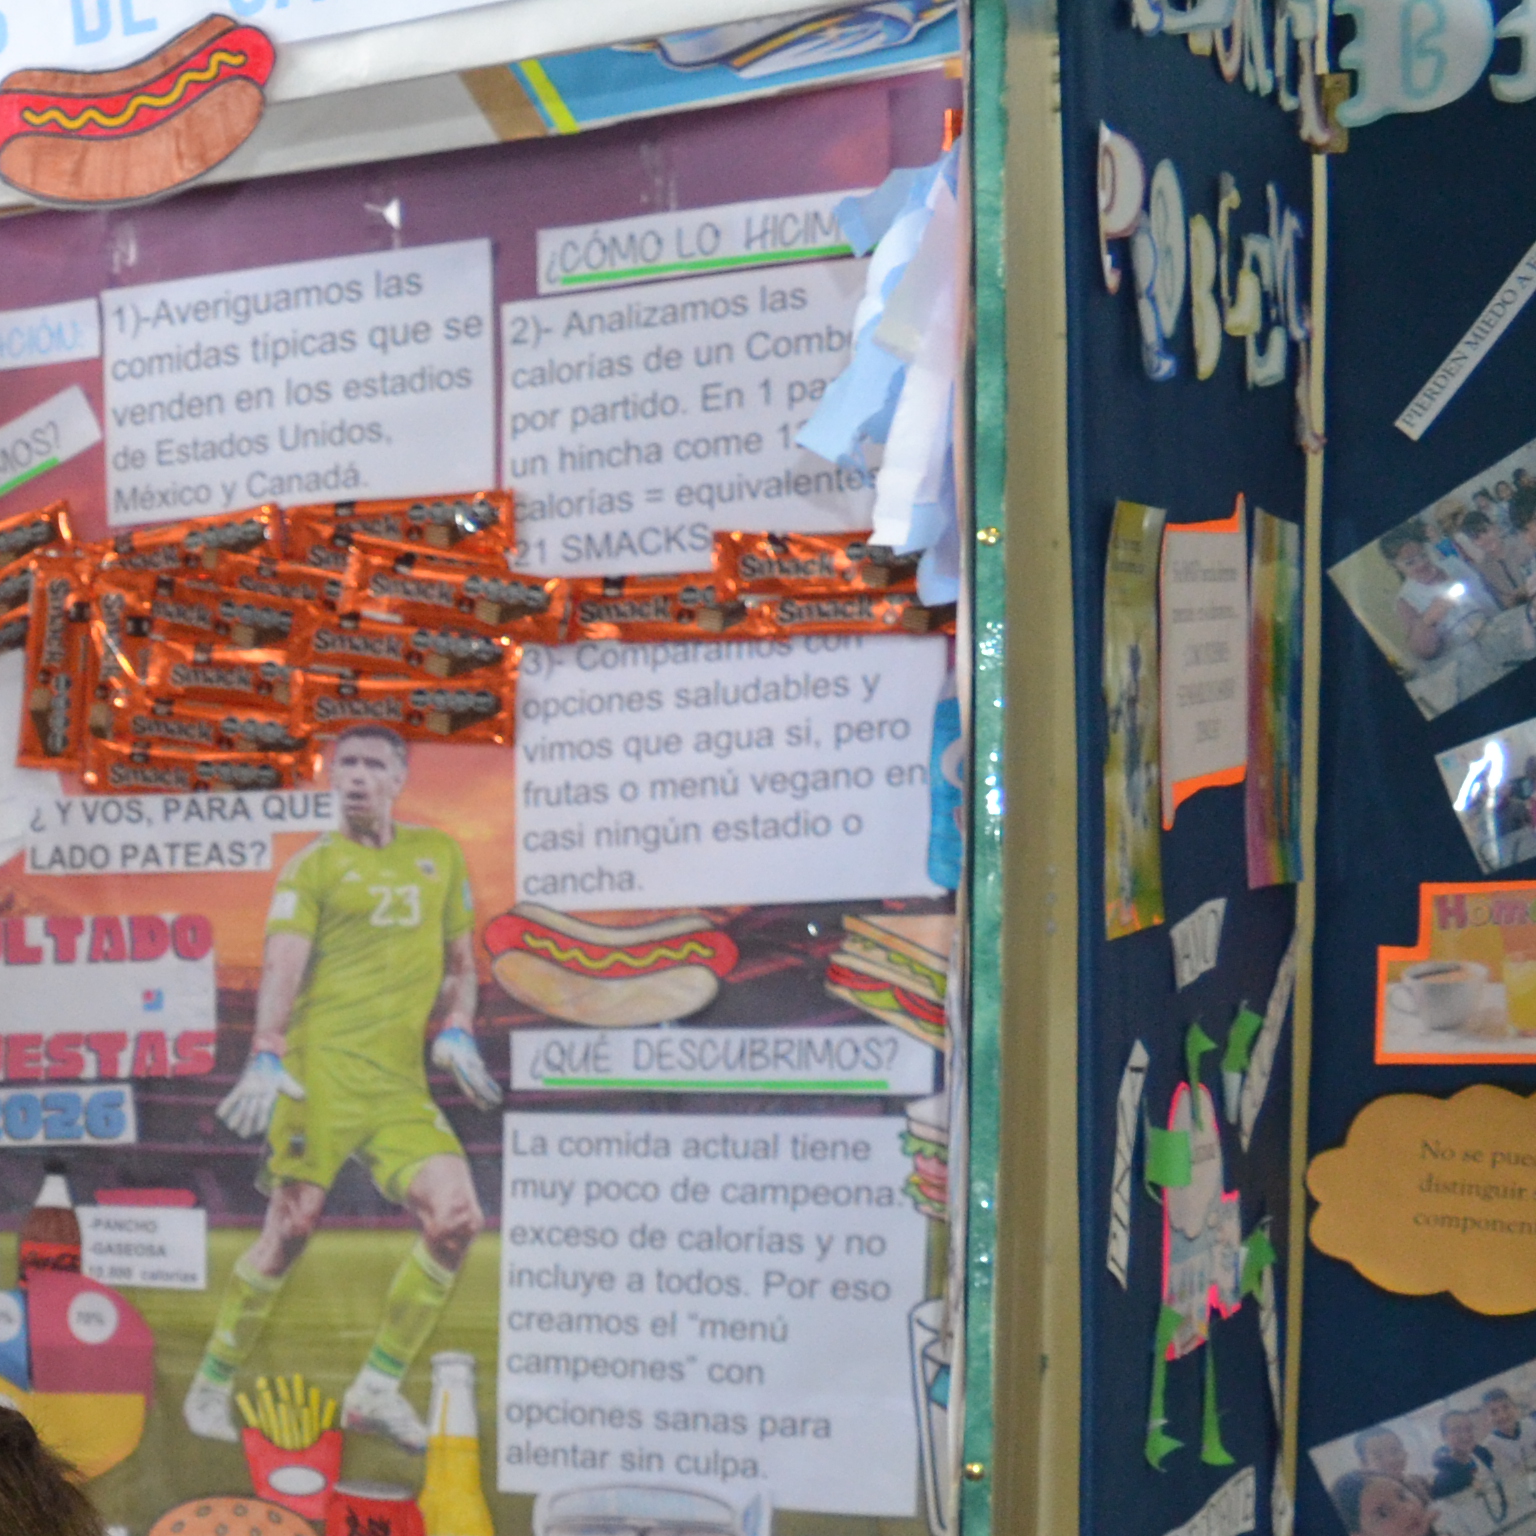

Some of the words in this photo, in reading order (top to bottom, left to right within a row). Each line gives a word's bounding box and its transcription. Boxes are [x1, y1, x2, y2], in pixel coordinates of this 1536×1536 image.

[546, 225, 662, 283] ¿CÓMO
[676, 221, 721, 260] LO
[375, 271, 423, 301] las
[563, 289, 749, 338] Analizamos
[760, 287, 808, 317] las
[111, 339, 240, 382] comidas
[251, 328, 356, 367] típicas
[368, 320, 431, 354] que
[443, 314, 483, 338] se
[511, 353, 633, 393] calorías
[643, 347, 682, 375] de
[694, 344, 733, 369] un
[1402, 350, 1468, 428] PIERDEN
[1465, 288, 1518, 351] MIEDO
[111, 390, 224, 429] venden
[235, 385, 275, 413] en
[285, 376, 329, 408] los
[342, 365, 472, 400] estadios
[510, 409, 554, 442] por
[570, 389, 686, 432] partido.
[701, 383, 745, 413] En
[111, 439, 145, 472] de
[156, 430, 268, 467] Estados
[511, 451, 548, 476] un
[559, 437, 662, 476] hincha
[675, 430, 764, 462] come
[113, 478, 211, 517] México
[223, 479, 238, 508] y
[245, 462, 368, 502] Canadá.
[561, 524, 712, 564] SMACKS
[522, 685, 663, 723] opciones
[674, 667, 850, 711] saludables
[862, 674, 881, 703] y
[523, 730, 613, 763] vimos
[623, 729, 683, 761] que
[693, 723, 774, 758] agua
[834, 716, 911, 749] pero
[523, 779, 609, 810] frutas
[648, 766, 740, 799] menú
[749, 766, 873, 798] vegano
[885, 763, 926, 787] en
[83, 798, 154, 828] VOS,
[163, 796, 249, 823] PARA
[263, 794, 331, 821] QUE
[523, 826, 585, 852] casi
[595, 813, 702, 852] ningún
[713, 809, 832, 842] estadio
[29, 844, 109, 870] LADO
[120, 842, 266, 869] PATEAS?
[523, 866, 644, 895] cancha.
[369, 885, 421, 927] 23
[530, 1033, 612, 1081] ¿QUÉ
[633, 1035, 900, 1072] DESCUBRIMOS?
[511, 1129, 548, 1156] La
[557, 1131, 671, 1160] comida
[683, 1133, 779, 1161] actual
[791, 1134, 872, 1161] tiene
[511, 1178, 575, 1204] muy
[584, 1180, 660, 1205] poco
[673, 1174, 711, 1202] de
[509, 1225, 619, 1249] exceso
[629, 1221, 667, 1249] de
[678, 1224, 803, 1255] calorías
[817, 1233, 834, 1262] y
[846, 1232, 887, 1256] no
[508, 1264, 615, 1297] incluye
[656, 1269, 750, 1298] todos.
[764, 1272, 820, 1301] Por
[832, 1278, 891, 1302] eso
[508, 1311, 639, 1336] creamos
[650, 1311, 678, 1338] el
[708, 1362, 764, 1385] con
[505, 1401, 644, 1431] opciones
[655, 1410, 748, 1434] sanas
[758, 1417, 831, 1442] para
[505, 1441, 611, 1469] alentar
[620, 1442, 664, 1472] sin
[676, 1447, 767, 1481] culpa.
